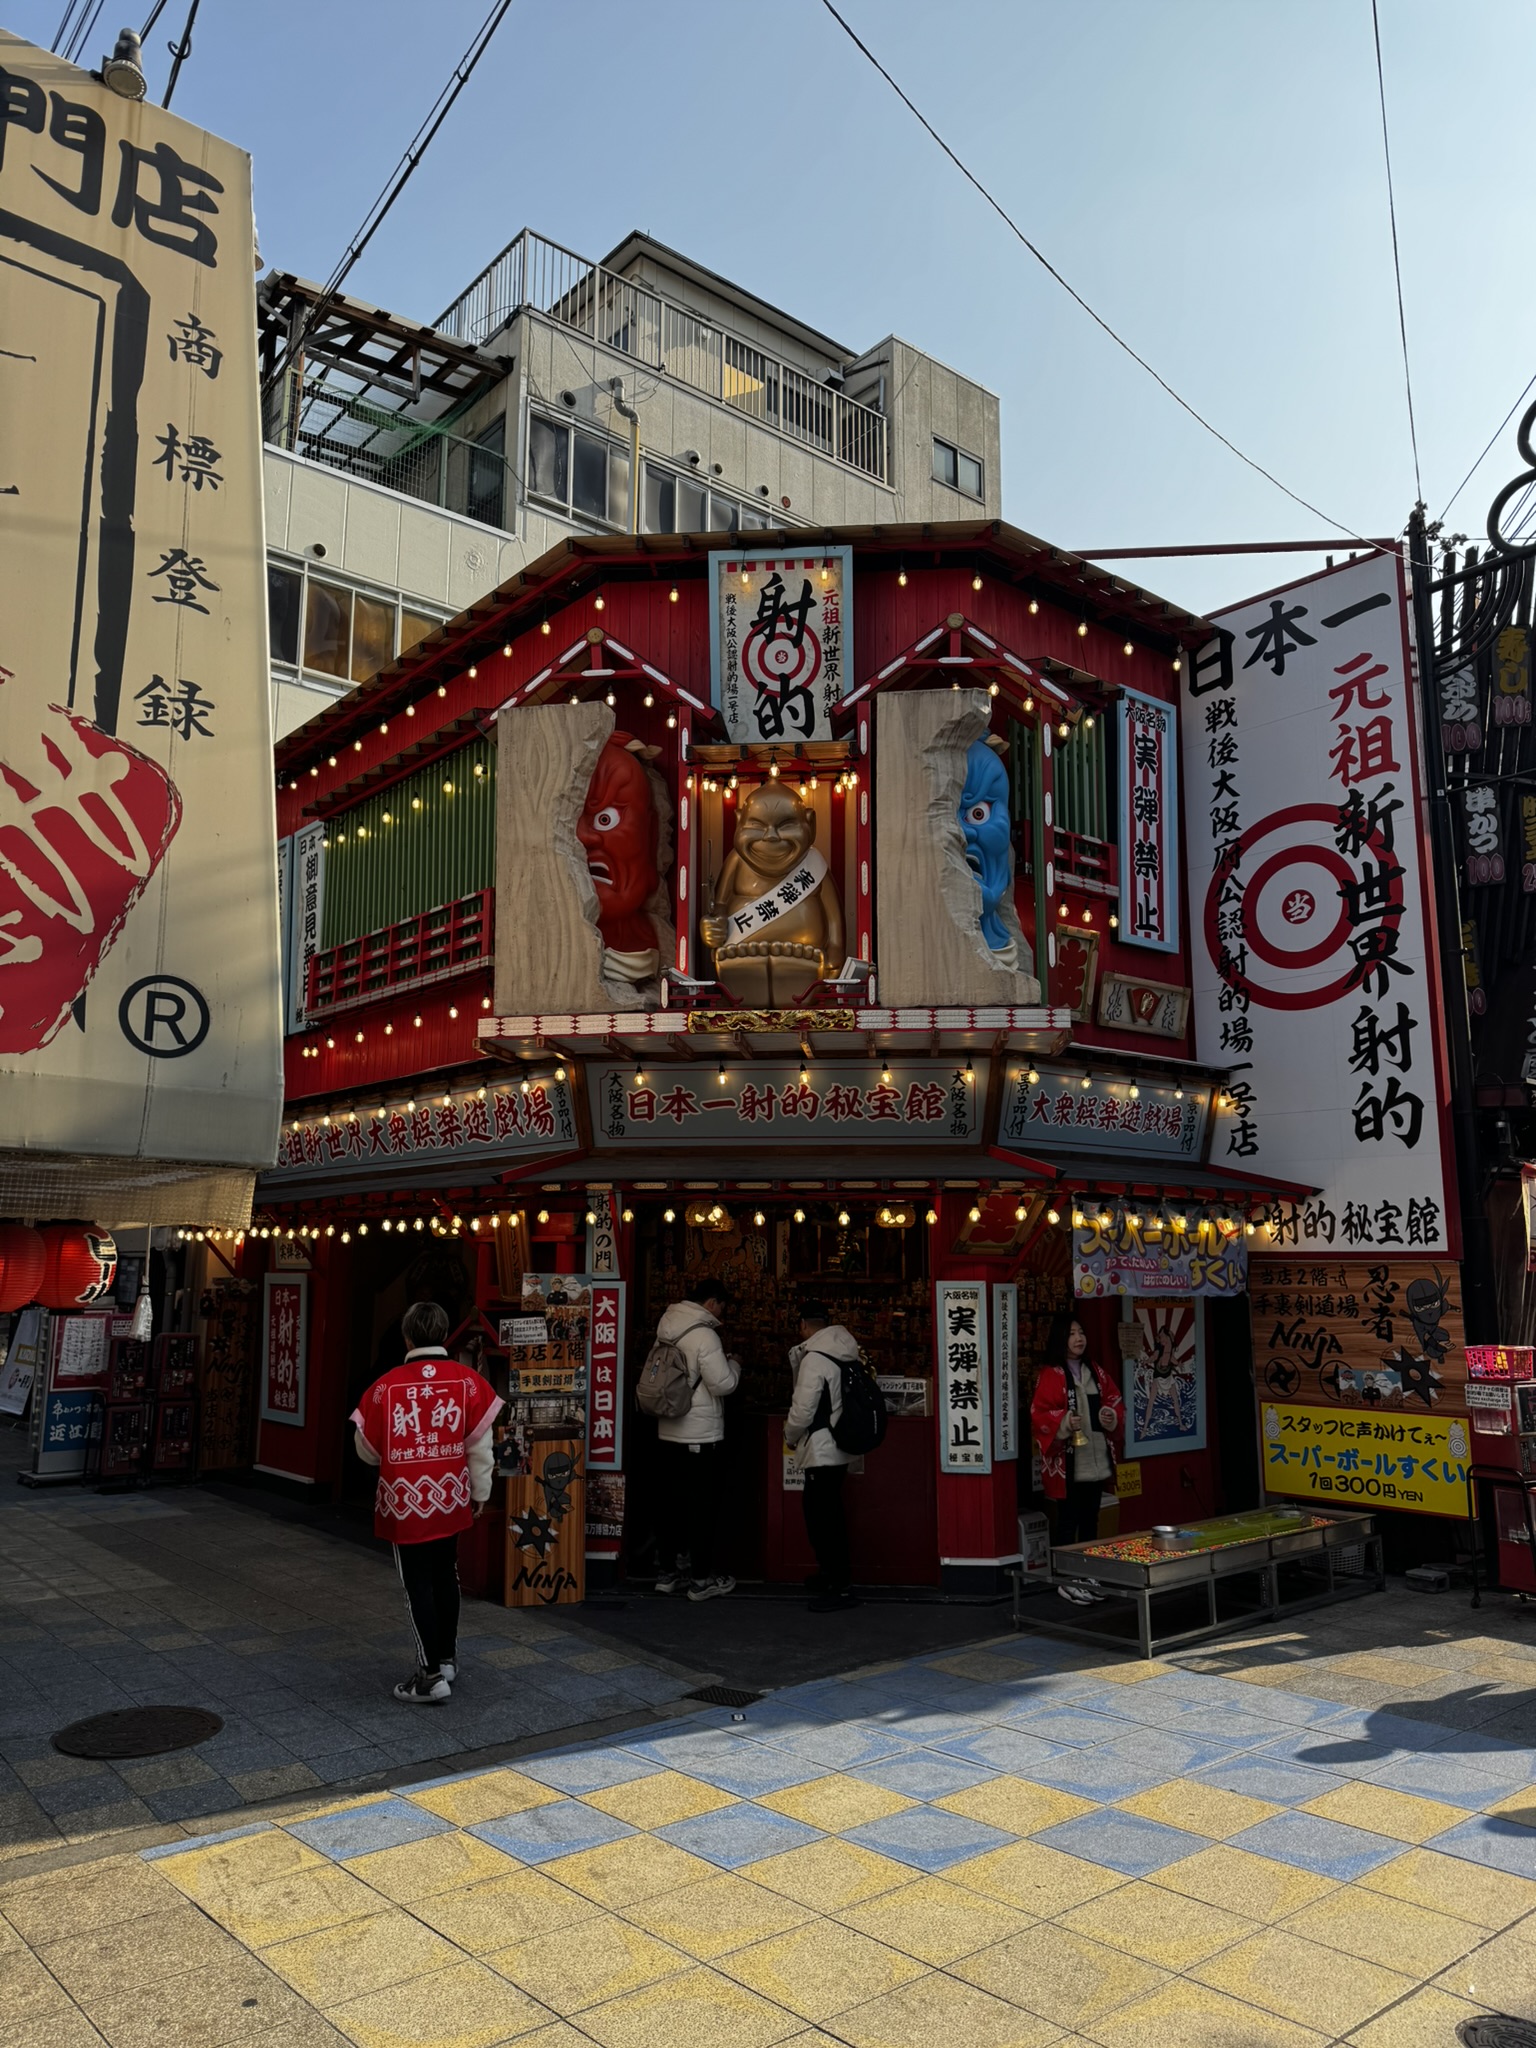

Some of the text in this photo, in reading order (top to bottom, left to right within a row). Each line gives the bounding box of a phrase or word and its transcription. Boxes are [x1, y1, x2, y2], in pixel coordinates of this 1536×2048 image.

[133, 312, 225, 741] 商標登録
[750, 572, 817, 740] 射的
[1188, 592, 1392, 697] 日本一
[1125, 705, 1167, 734] 大阪名物
[1134, 734, 1160, 933] 実弾禁止
[1465, 786, 1499, 855] 串かつ
[1465, 854, 1505, 885] 100
[733, 866, 817, 935] 実弾禁止
[1205, 696, 1260, 1157] 戦後大阪府公認射的場一号店
[1329, 652, 1425, 1150] 元祖新世界射的
[608, 1071, 625, 1138] 大阪名物
[626, 1081, 948, 1125] 日本一射的秘宝館
[949, 1069, 968, 1137] 大阪名物
[1028, 1089, 1184, 1140] 大衆娯楽遊戯場
[1180, 1095, 1200, 1152] 景品付
[1189, 1257, 1246, 1290] すくい
[1259, 1268, 1328, 1288] 当店2階
[1255, 1294, 1359, 1319] 手裏剣道場
[1361, 1264, 1401, 1343] 忍者
[277, 1307, 294, 1389] 射的
[511, 1343, 585, 1362] 当店2階
[591, 1295, 617, 1455] 大阪一は日本一
[948, 1306, 981, 1447] 実弾禁止
[406, 1385, 449, 1400] 日本一
[521, 1374, 574, 1387] 手裏剣道場
[391, 1397, 463, 1438] 射的
[415, 1431, 439, 1444] 元祖
[390, 1442, 464, 1462] 新世界道頓堀
[1268, 1443, 1467, 1484] スーパーボールすくい
